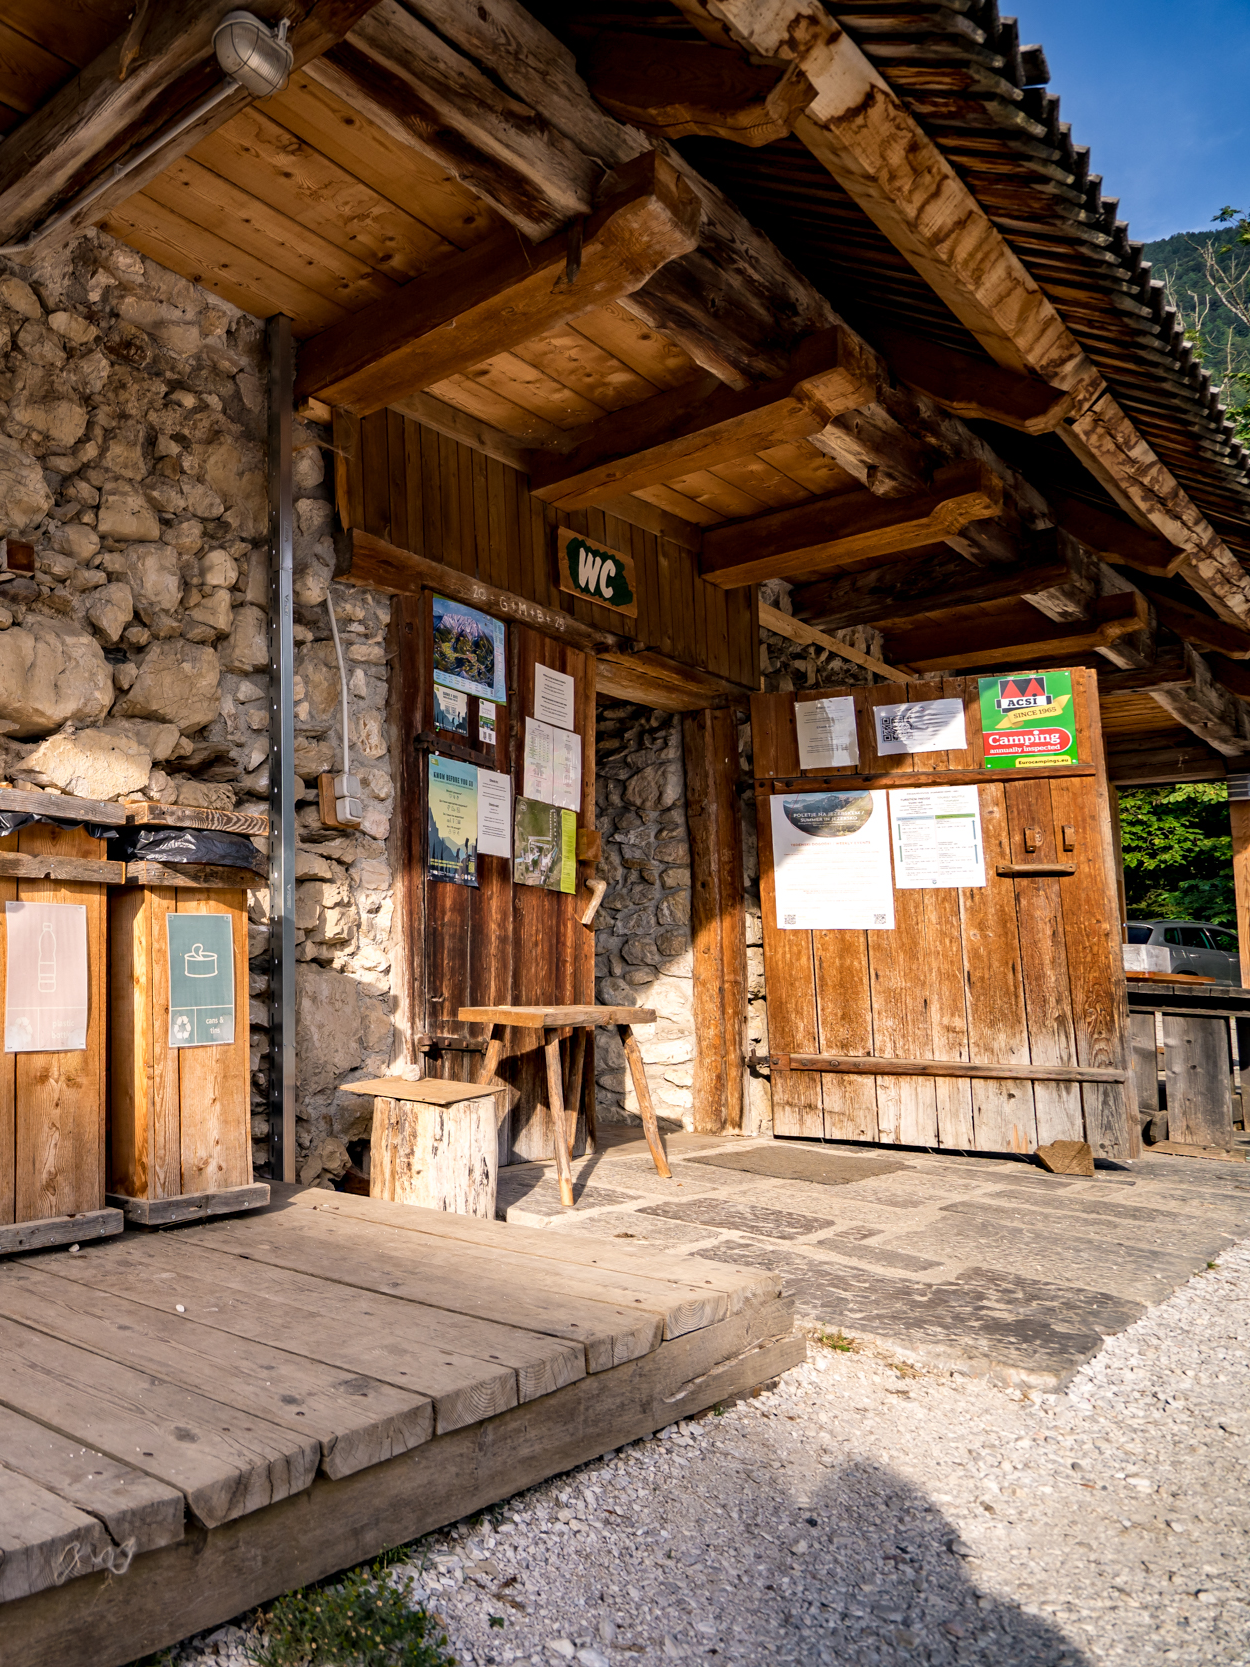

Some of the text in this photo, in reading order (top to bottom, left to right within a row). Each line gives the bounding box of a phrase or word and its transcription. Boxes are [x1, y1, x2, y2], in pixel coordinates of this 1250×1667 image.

[578, 547, 616, 598] WC
[1013, 706, 1057, 719] SINCE 1965
[988, 730, 1060, 746] Camping
[989, 744, 1061, 754] annually inspected
[433, 771, 445, 780] KNOW
[446, 774, 460, 784] BEFORE
[460, 777, 468, 786] YOU
[52, 1019, 74, 1029] plastic
[219, 1016, 224, 1024] &
[210, 1026, 221, 1034] tins
